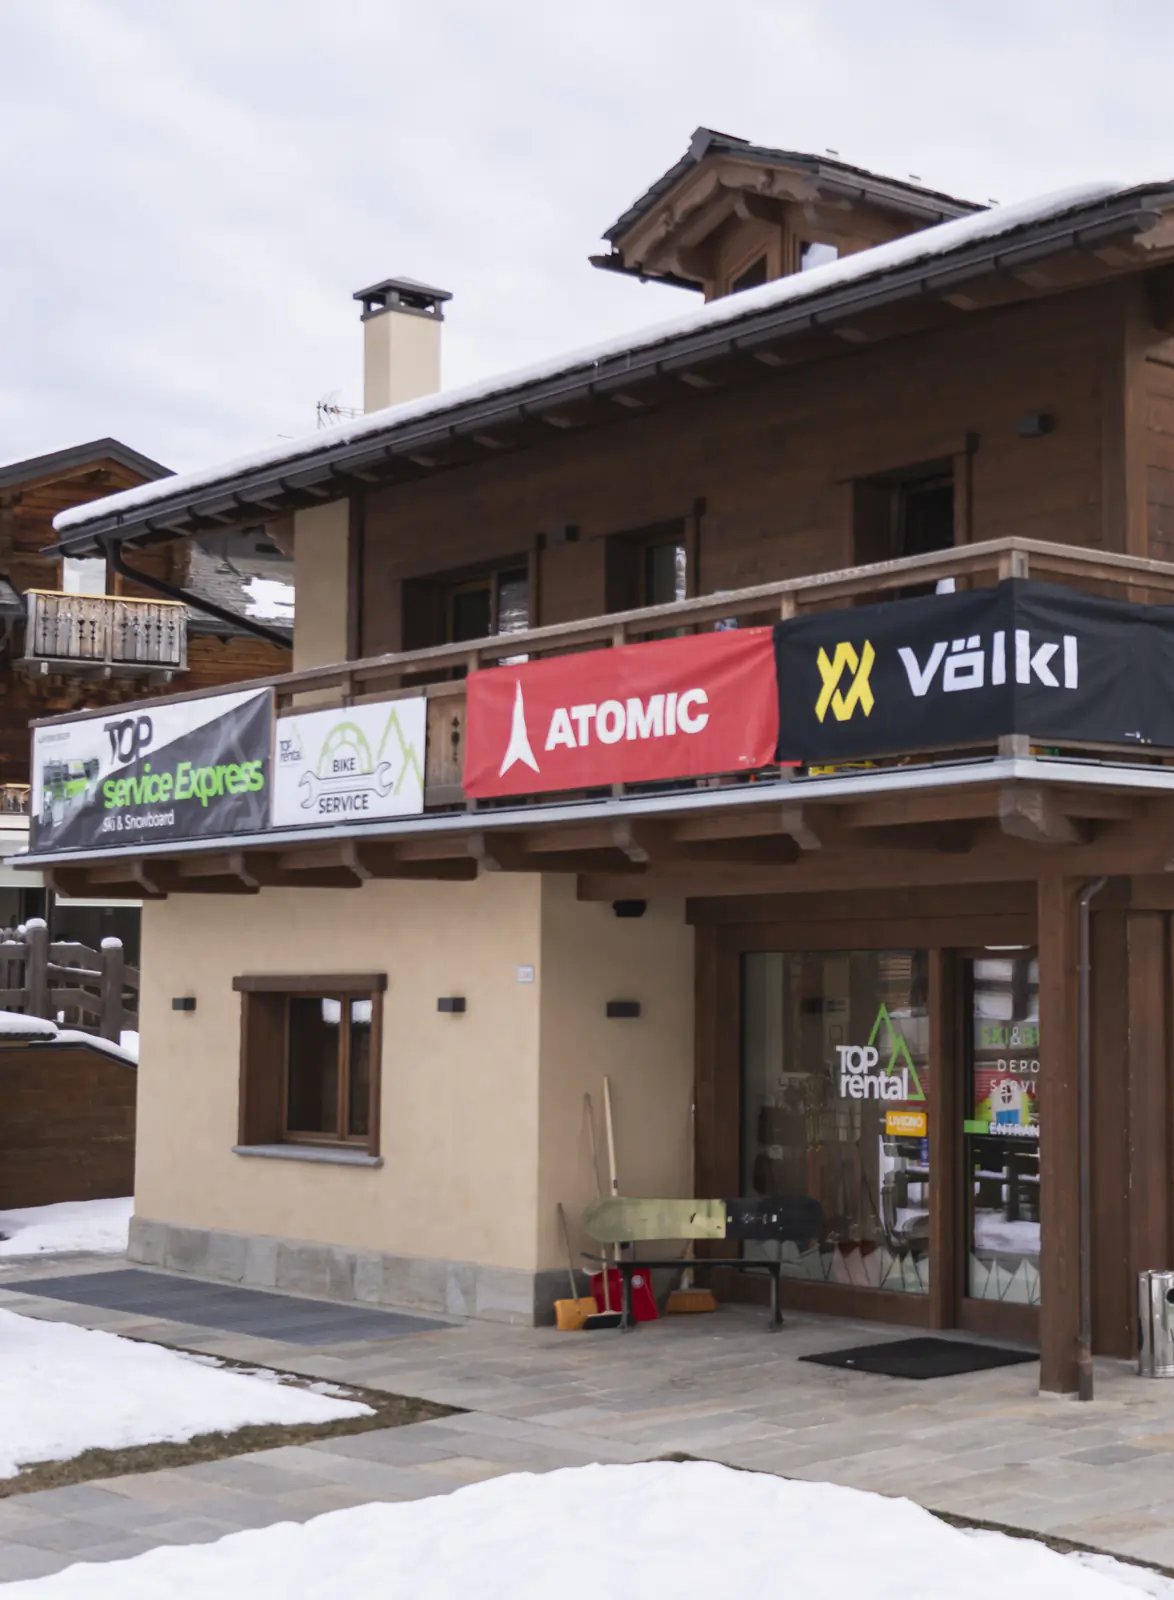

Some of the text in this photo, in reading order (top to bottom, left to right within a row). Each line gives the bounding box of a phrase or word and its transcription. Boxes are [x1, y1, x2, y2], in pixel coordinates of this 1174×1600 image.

[897, 629, 1078, 696] Völkl
[545, 688, 709, 751] ATOMIC
[104, 715, 153, 765] TOP
[332, 757, 356, 772] BIKE
[103, 759, 265, 808] service Express
[102, 809, 175, 832] Ski & Snowboard
[318, 794, 369, 814] SERVICE
[836, 1045, 879, 1074] TOP
[841, 1067, 908, 1100] rental
